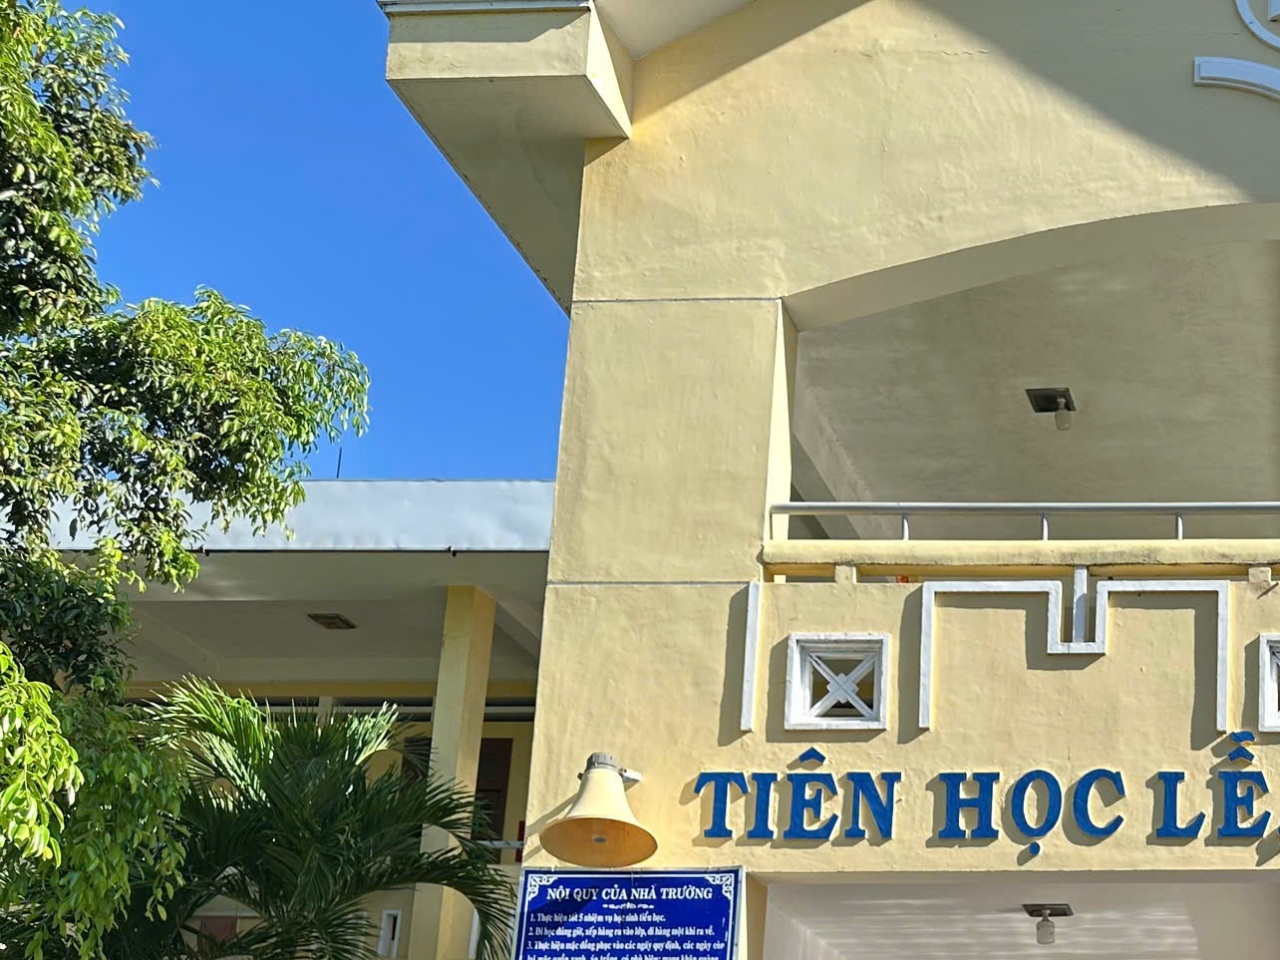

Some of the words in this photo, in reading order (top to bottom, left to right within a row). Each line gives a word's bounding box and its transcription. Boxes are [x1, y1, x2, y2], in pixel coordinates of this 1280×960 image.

[693, 747, 902, 841] TIÊN
[937, 768, 1126, 856] HỌC
[546, 885, 569, 901] NỘI
[573, 888, 599, 901] QUY
[602, 884, 627, 899] CỦA
[630, 887, 657, 899] NHÀ
[660, 885, 712, 899] TRƯỜNG
